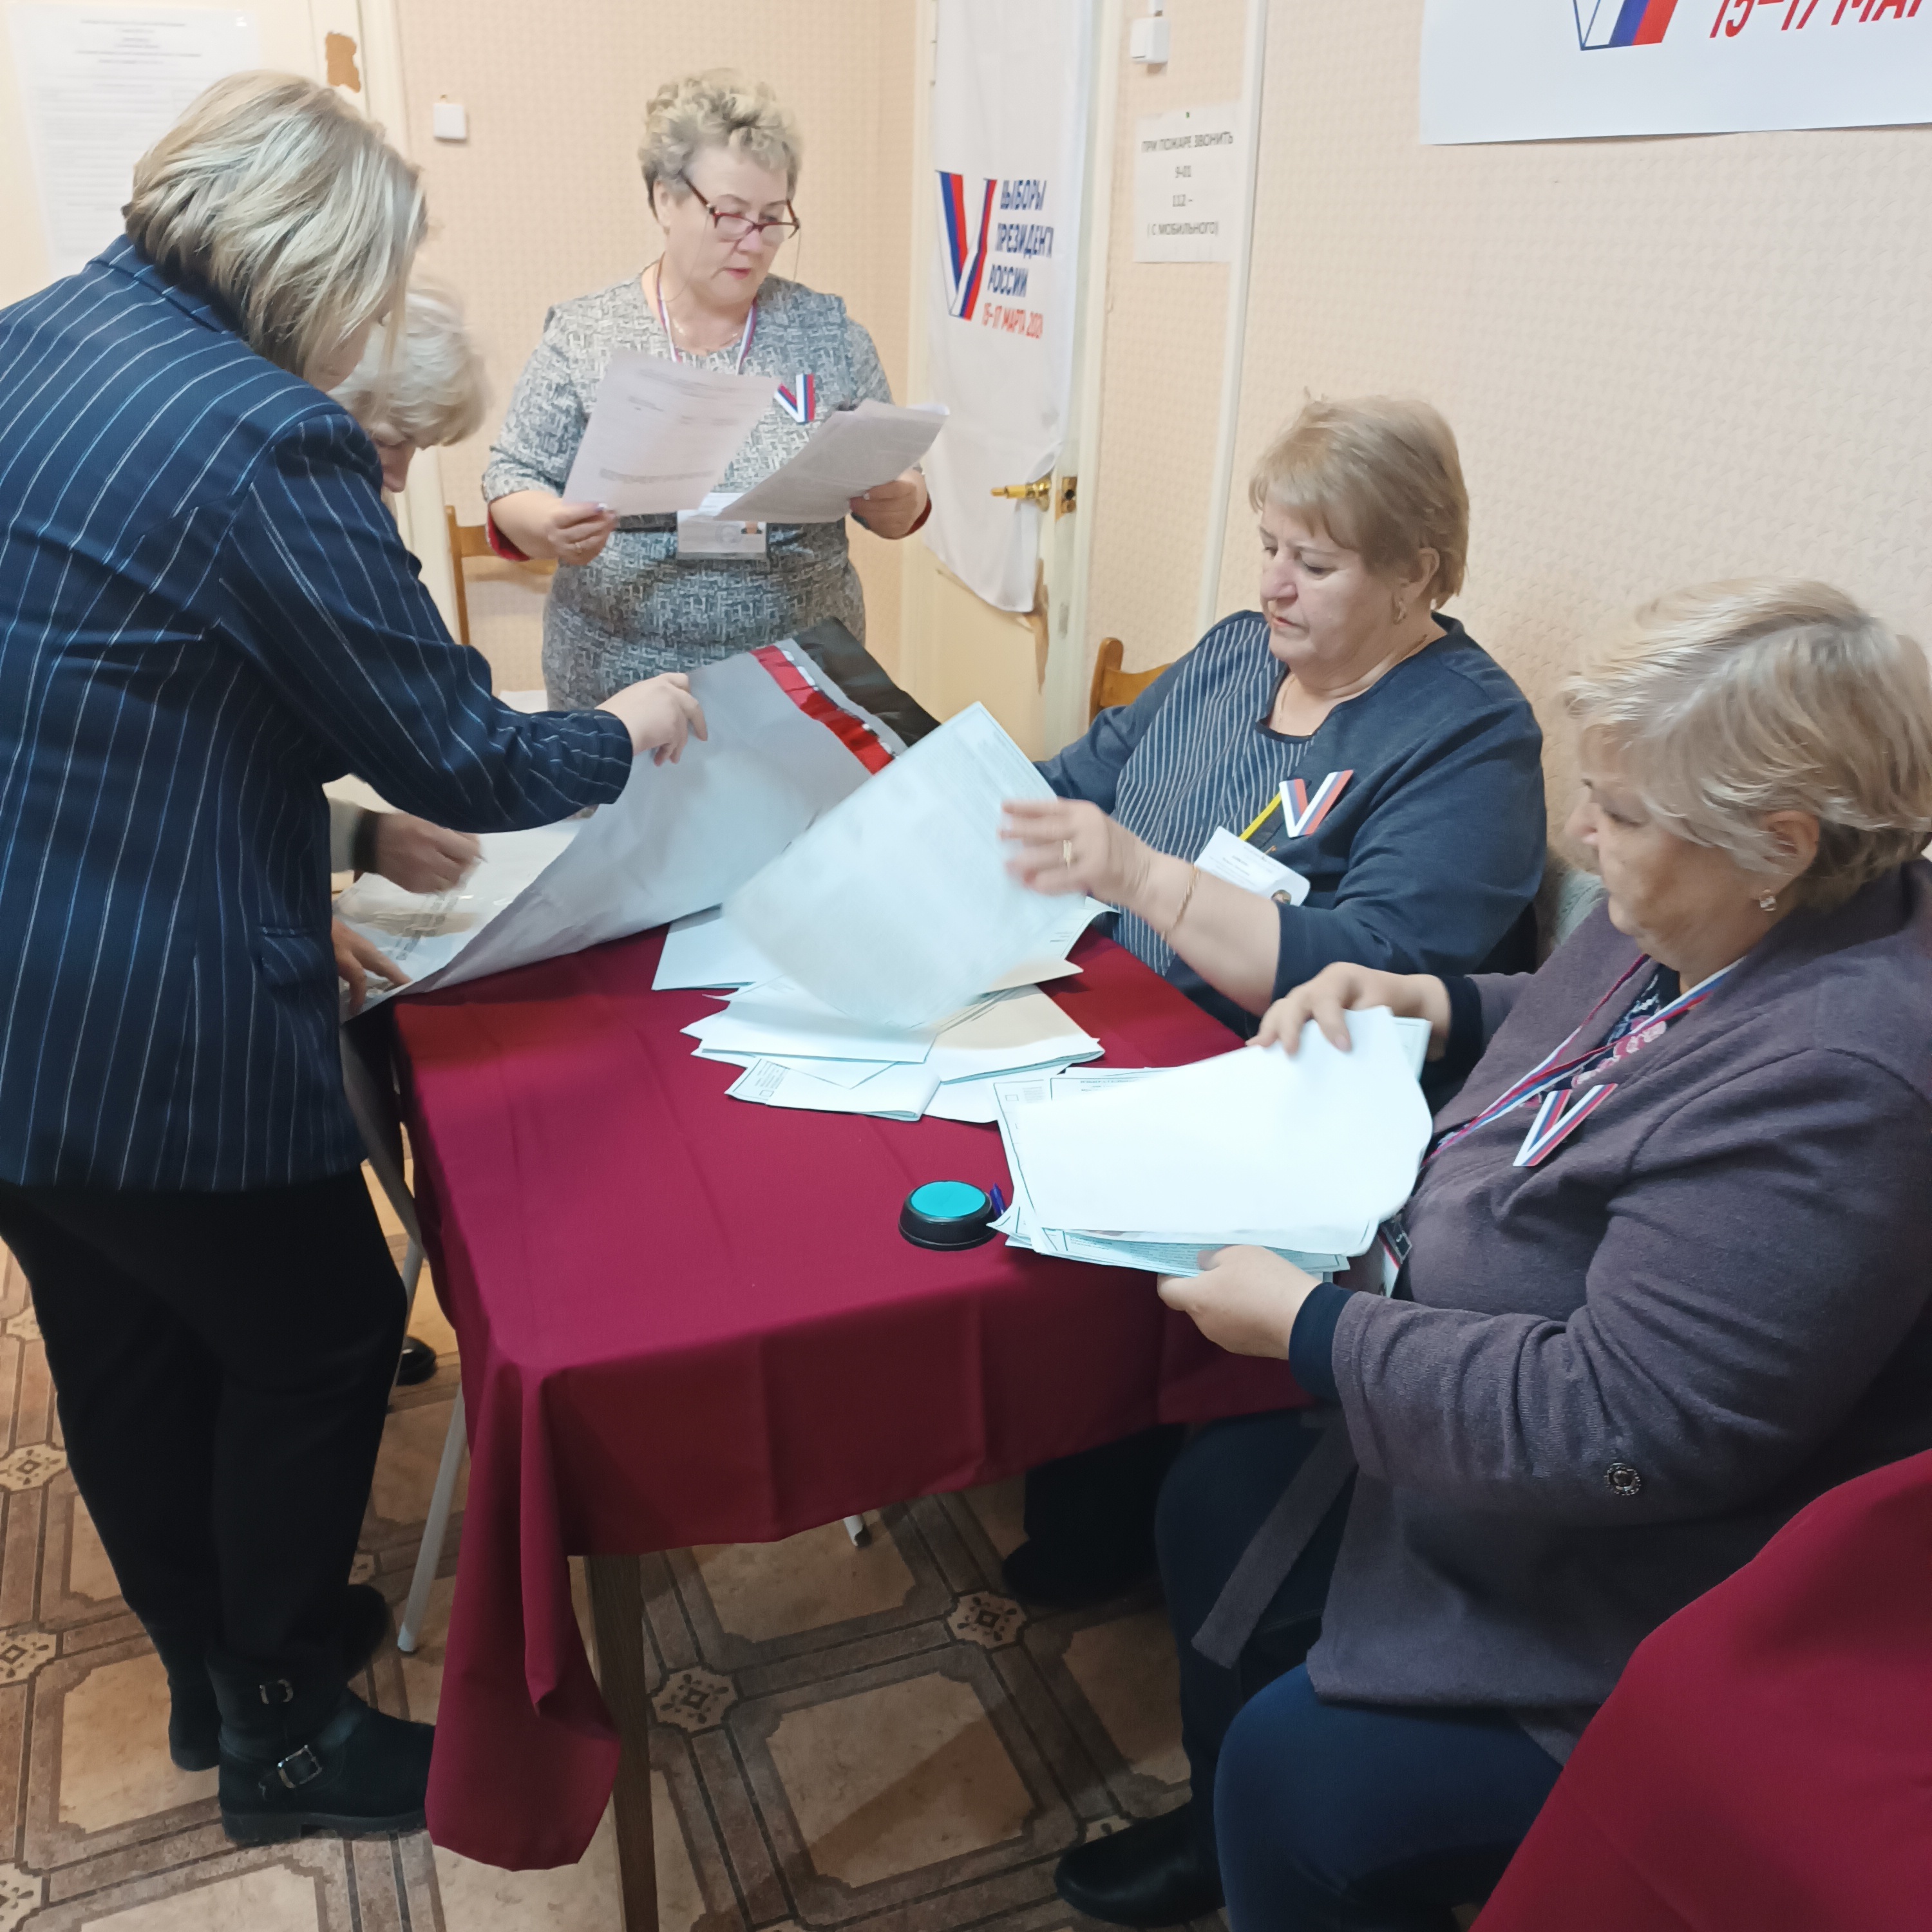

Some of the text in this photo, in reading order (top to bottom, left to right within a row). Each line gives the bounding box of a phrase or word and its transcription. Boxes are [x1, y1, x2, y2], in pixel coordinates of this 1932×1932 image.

[1142, 131, 1233, 153] ПРИ ПОЖАРЕ ЗВОНИТЬ
[987, 263, 1028, 298] РОССИИ
